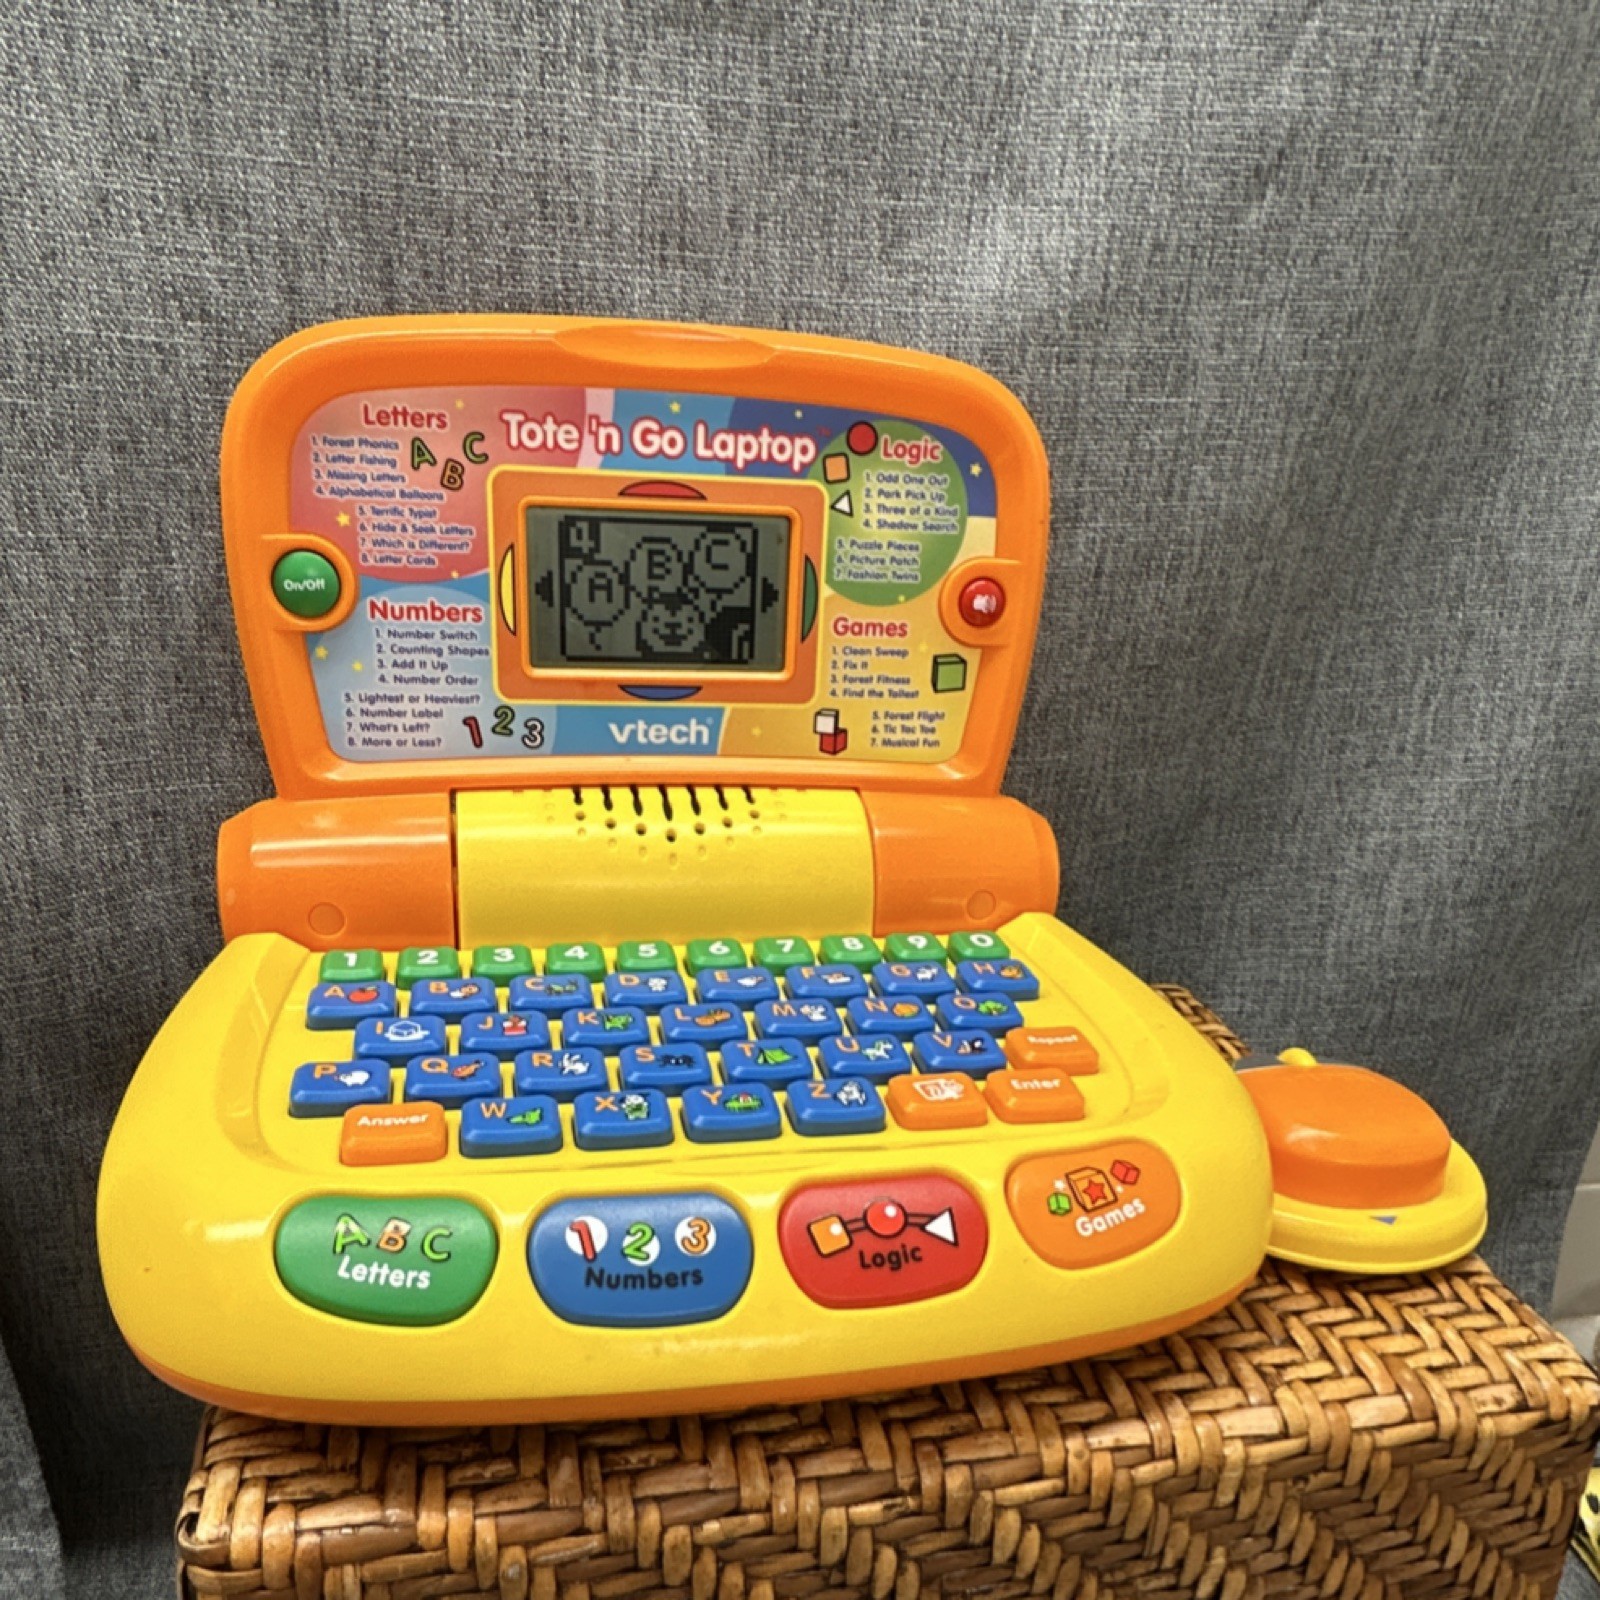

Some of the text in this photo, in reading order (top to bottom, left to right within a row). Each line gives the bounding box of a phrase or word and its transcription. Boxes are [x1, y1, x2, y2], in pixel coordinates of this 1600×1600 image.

[363, 404, 448, 428] Letters
[323, 437, 399, 449] Forest Phonics
[463, 431, 489, 464] C
[501, 411, 580, 451] Tote
[631, 417, 685, 458] Go
[695, 421, 818, 474] Laptop
[411, 436, 437, 470] A
[883, 437, 941, 465] Logic
[326, 454, 397, 468] Letter Fishing
[327, 470, 405, 483] Missing Letters
[441, 458, 464, 490] B
[876, 474, 947, 485] Odd One Out
[330, 487, 443, 500] Alphabetical Balloons
[878, 489, 945, 502] Park Pick Up
[371, 507, 404, 516] Terrific
[877, 505, 905, 514] Three
[909, 506, 920, 514] of
[935, 506, 957, 515] Kind
[372, 524, 396, 533] Hide
[412, 525, 436, 534] Seek
[440, 527, 472, 535] Letters
[877, 520, 957, 531] Shadow Search
[372, 538, 403, 548] Which
[409, 539, 415, 549] is
[850, 540, 919, 551] Puzzle Pieces
[374, 554, 436, 565] Letter Cards
[706, 539, 729, 570] C
[648, 550, 671, 579] B
[850, 556, 918, 566] Picture Patch
[848, 571, 918, 581] Fashion Twins
[589, 572, 612, 603] A
[368, 600, 482, 622] Numbers
[833, 617, 908, 637] Games
[388, 630, 434, 639] Number
[440, 630, 477, 640] Switch
[390, 645, 443, 657] Counting
[448, 646, 489, 657] Shapes
[842, 647, 909, 658] Clean Sweep
[391, 660, 414, 669] Add
[419, 660, 427, 669] It
[432, 661, 448, 672] Up
[843, 661, 857, 669] Fix
[394, 675, 440, 684] Number
[445, 676, 478, 685] Order
[843, 676, 873, 684] Forest
[877, 676, 910, 684] Fitness
[358, 693, 404, 705] Lightest
[425, 694, 480, 704] Heaviest?
[842, 689, 864, 698] Find
[868, 690, 883, 698] the
[888, 690, 919, 698] Tallest
[360, 708, 407, 718] Number
[412, 709, 443, 718] Label
[884, 712, 945, 722] Forest Flight
[491, 705, 515, 736] 2
[360, 723, 430, 732] What's Left?
[463, 716, 483, 748] 1
[522, 718, 544, 749] 3
[608, 718, 710, 745] vtech
[884, 725, 935, 734] Tic Tac Toe
[362, 738, 442, 747] More or Less?
[882, 739, 939, 747] Musical Fun
[776, 940, 794, 952] 7
[842, 937, 863, 950] 8
[907, 935, 927, 948] 9
[565, 945, 588, 959] 4
[638, 944, 658, 957] 5
[709, 942, 730, 954] 6
[344, 953, 358, 967] 1
[417, 950, 438, 964] 2
[493, 948, 515, 962] 3
[801, 968, 814, 978] F
[972, 963, 995, 974] H
[619, 975, 640, 985] D
[714, 971, 729, 982] E
[429, 982, 448, 994] B
[525, 978, 545, 990] C
[324, 986, 345, 998] A
[864, 1000, 888, 1011] N
[954, 997, 976, 1008] O
[675, 1008, 690, 1020] L
[772, 1003, 795, 1016] M
[478, 1016, 493, 1029] J
[578, 1012, 599, 1024] K
[376, 1022, 383, 1034] I
[836, 1038, 859, 1052] U
[933, 1035, 952, 1047] V
[635, 1048, 654, 1062] S
[737, 1044, 755, 1056] T
[420, 1059, 448, 1073] Q
[532, 1053, 552, 1067] R
[314, 1064, 337, 1078] P
[808, 1084, 829, 1098] Z
[1011, 1080, 1061, 1090] Enter
[595, 1096, 618, 1111] X
[702, 1090, 722, 1105] Y
[480, 1103, 506, 1117] W
[358, 1114, 429, 1126] Answer
[1076, 1198, 1145, 1237] Games
[333, 1213, 453, 1262] A B C
[569, 1218, 711, 1262] 1 2 3
[859, 1244, 923, 1271] Logic
[338, 1256, 431, 1289] Letters
[585, 1267, 704, 1289] Numbers
